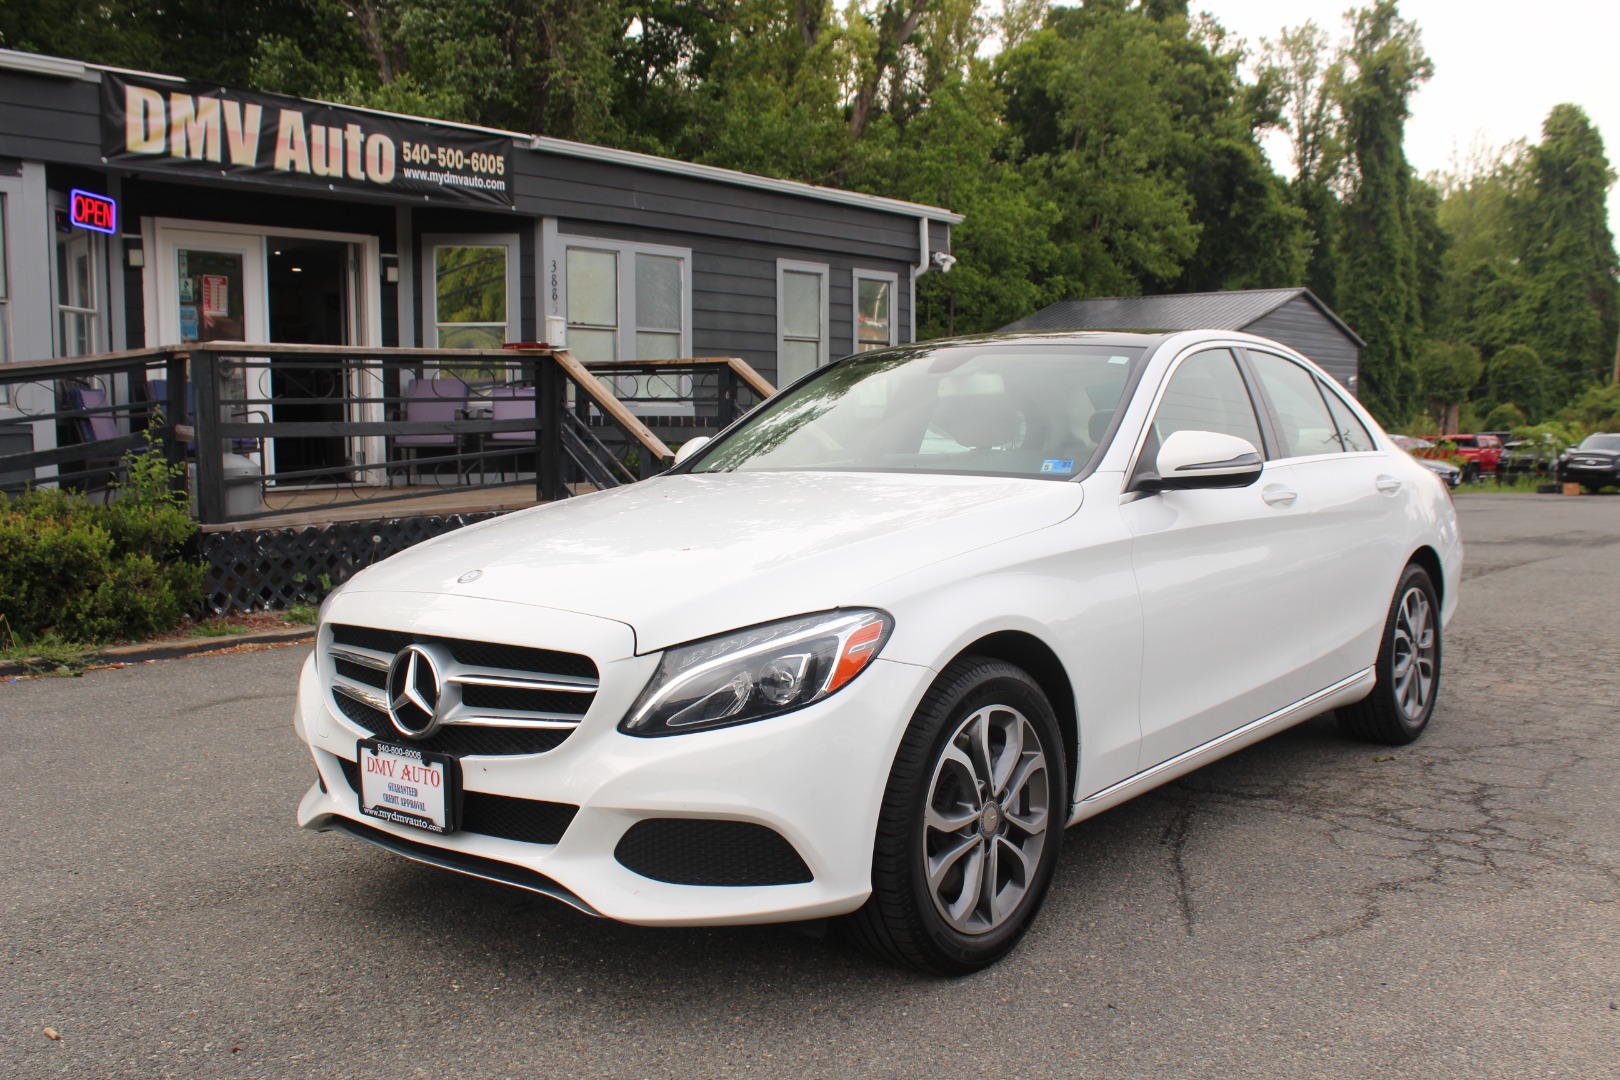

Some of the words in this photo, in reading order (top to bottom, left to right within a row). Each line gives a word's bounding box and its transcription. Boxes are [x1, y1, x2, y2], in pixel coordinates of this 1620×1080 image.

[124, 84, 262, 167] DMV
[273, 108, 396, 184] Auto
[402, 140, 505, 176] 540-500-6005
[403, 166, 506, 191] www.mydmvauto.com
[74, 194, 113, 229] OPEN
[367, 756, 397, 778] DMV
[401, 764, 440, 788] AUTO
[382, 792, 400, 806] CREDIT
[400, 796, 426, 812] APPROVAL
[387, 781, 418, 798] GUARANTEED
[363, 806, 443, 833] www.mydmvauto.com
